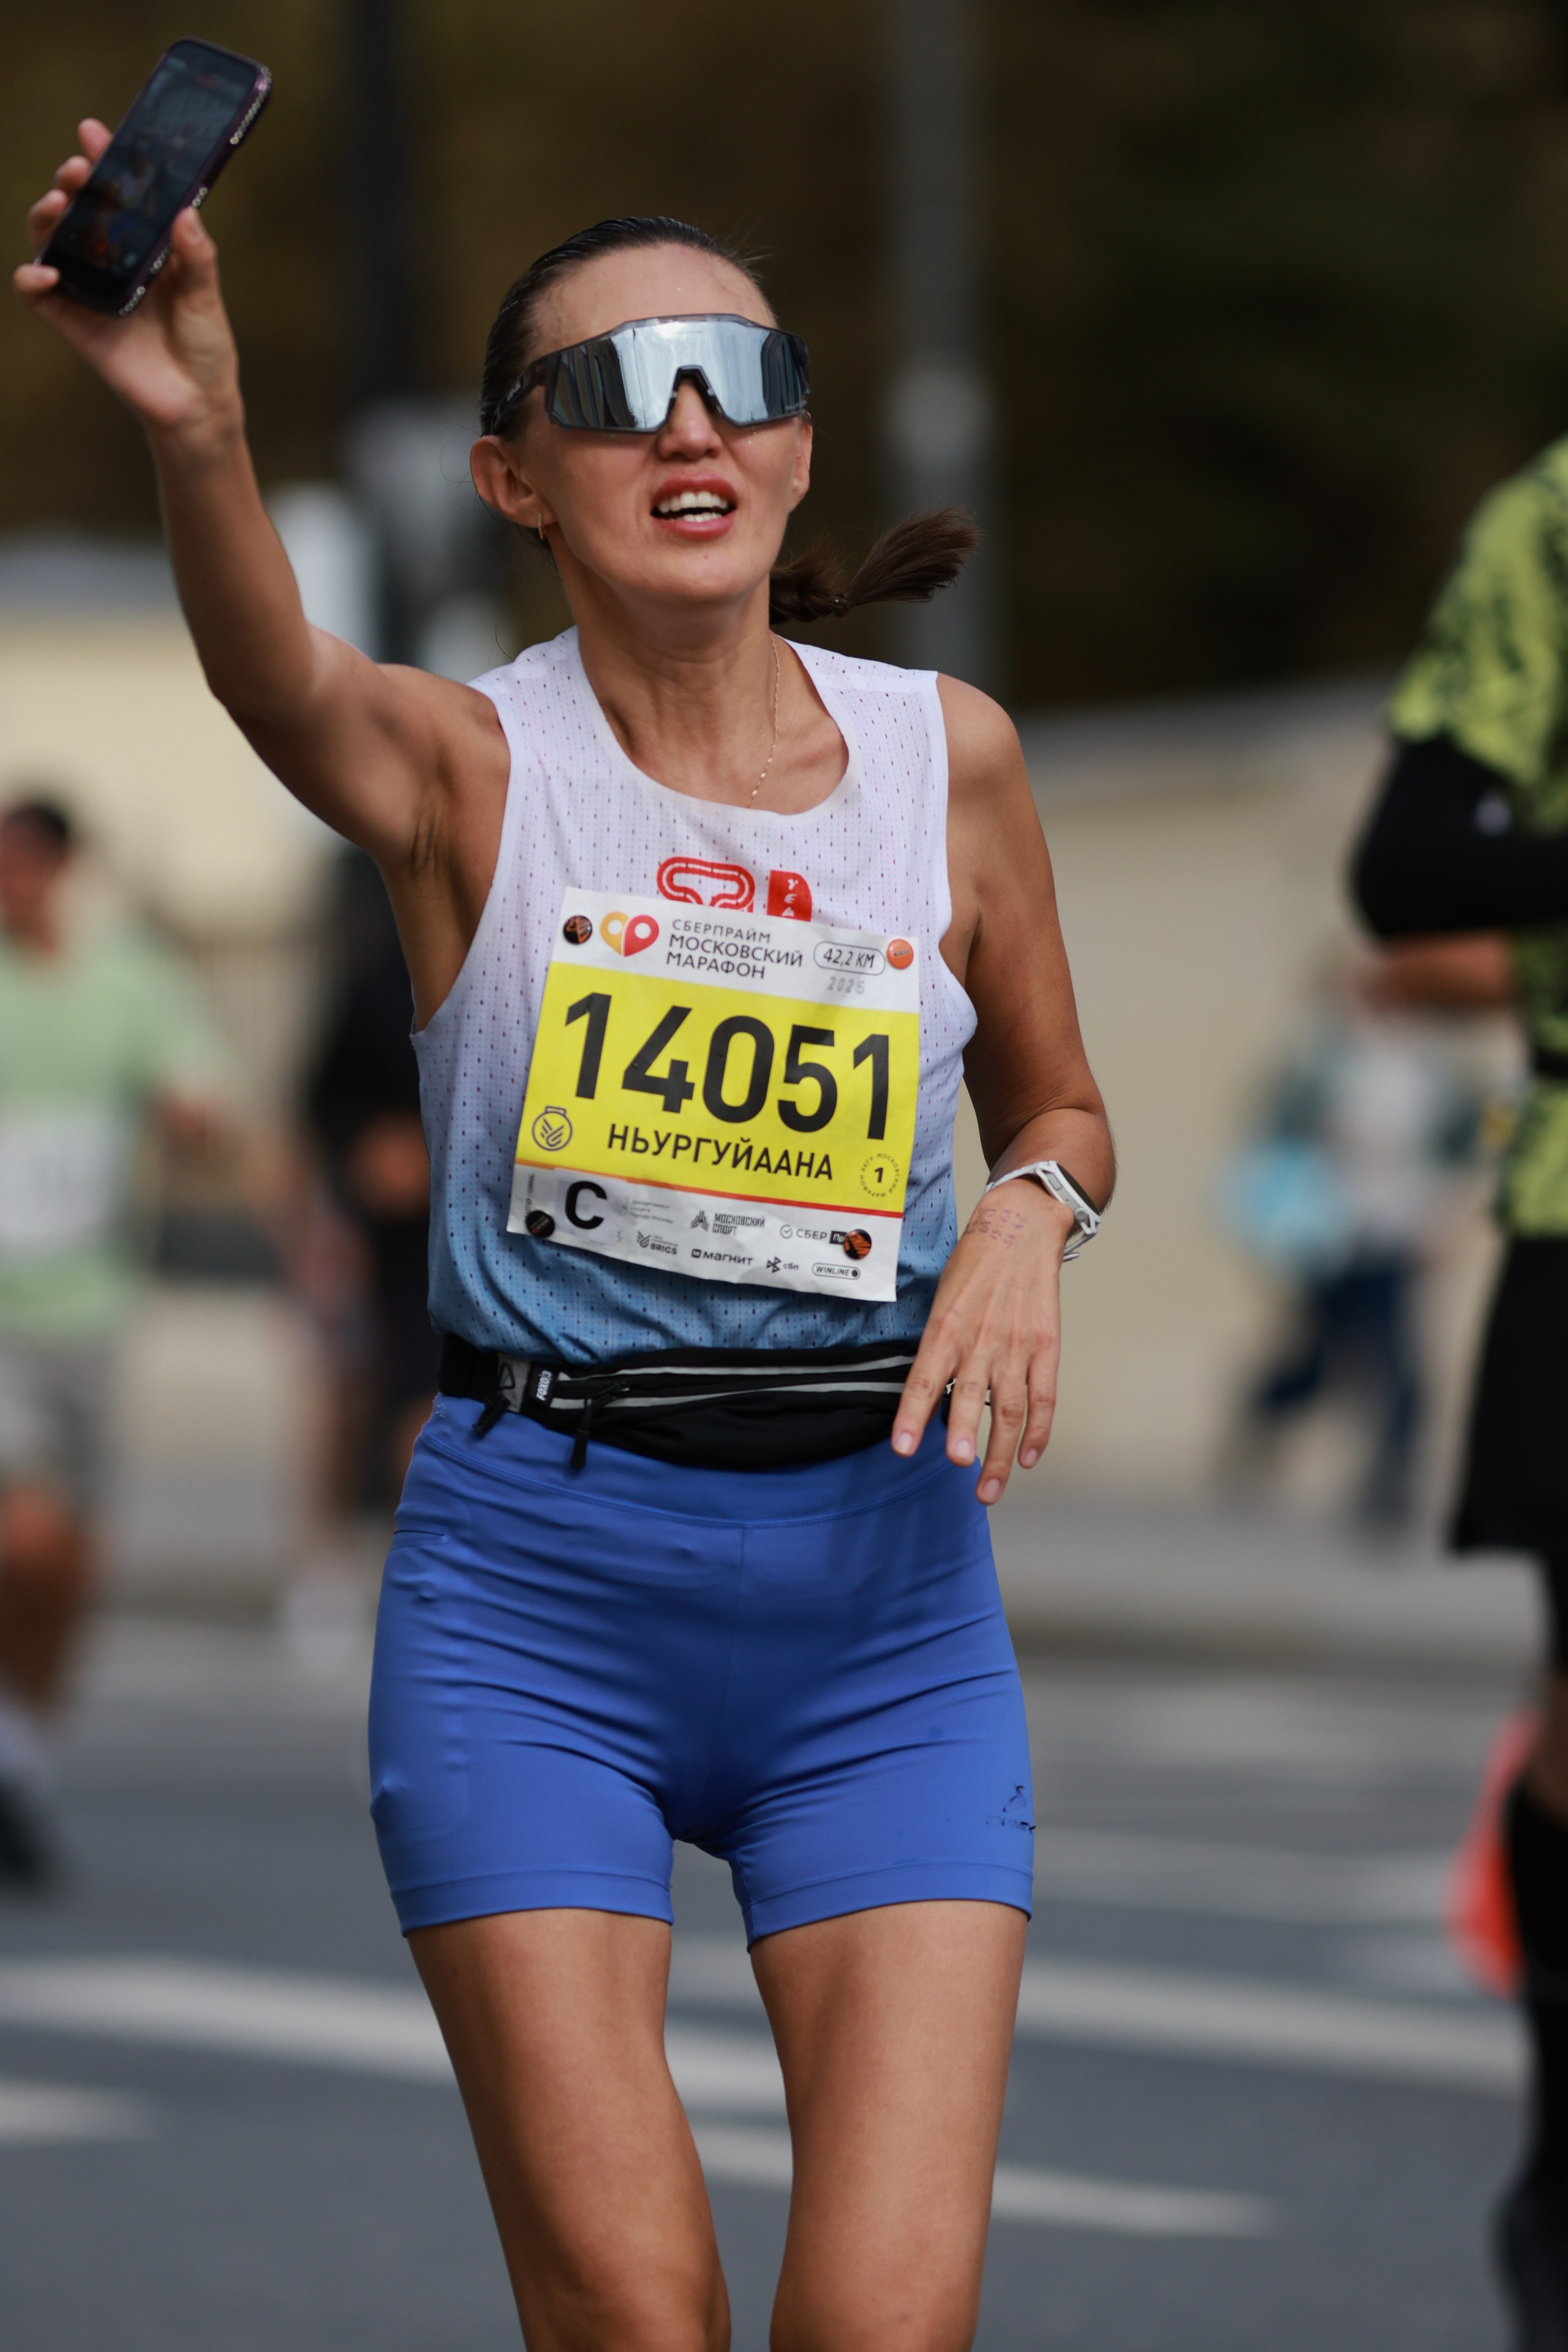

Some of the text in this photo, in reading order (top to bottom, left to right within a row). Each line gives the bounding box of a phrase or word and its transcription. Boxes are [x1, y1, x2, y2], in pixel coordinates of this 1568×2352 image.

[673, 919, 771, 944] СБЕРПРАЙМ
[669, 934, 803, 968] МОСКОВСКИЙ
[823, 948, 853, 967] 42,2
[666, 952, 765, 979] МАРАФОН
[564, 992, 890, 1141] 14051
[607, 1123, 834, 1181] НЬУРГУЙААНА
[874, 1167, 884, 1183] 1
[712, 1224, 737, 1235] СПОРТ
[713, 1213, 765, 1229] МОСКОВСКИЙ
[796, 1229, 827, 1240] СБЕР
[703, 1251, 753, 1265] магнит
[816, 1265, 850, 1276] WINLINE
